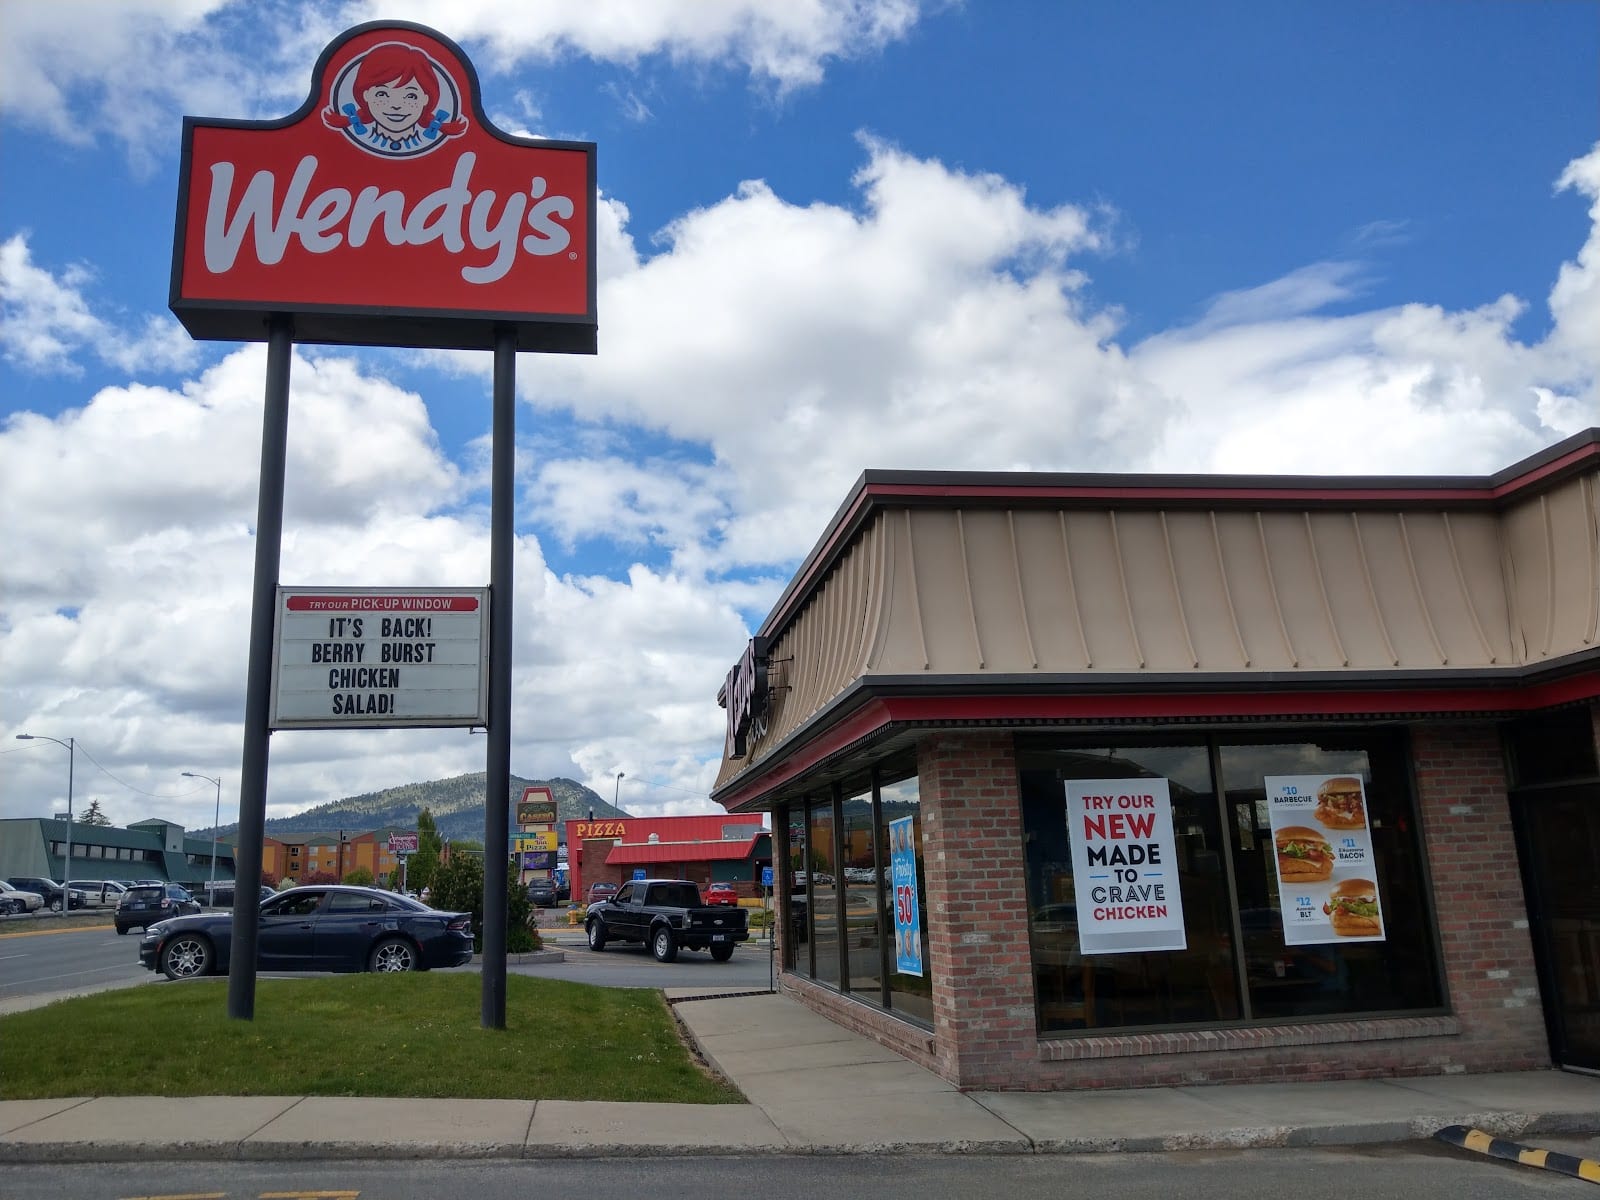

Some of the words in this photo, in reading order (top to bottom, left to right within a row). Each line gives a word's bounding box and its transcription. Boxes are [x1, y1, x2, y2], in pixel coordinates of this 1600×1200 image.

[204, 152, 574, 284] Wendy's
[309, 601, 329, 609] TRY
[329, 601, 349, 609] OUR
[351, 599, 399, 609] PICK-UP
[401, 599, 452, 609] WINDOW
[329, 618, 363, 638] IT'S
[381, 618, 431, 638] BACK!
[312, 643, 365, 663] BERRY
[381, 643, 436, 663] BURST
[329, 668, 400, 690] CHICKEN
[332, 693, 394, 715] SALAD!
[1082, 796, 1114, 810] TRY
[1118, 795, 1155, 809] OUR
[1274, 796, 1312, 804] BARBECUE
[576, 822, 626, 837] PIZZA
[1083, 813, 1156, 840] NEW
[1087, 844, 1162, 867] MADE
[1114, 868, 1138, 883] TO
[1091, 884, 1166, 904] CRAVE
[1093, 905, 1168, 921] CHICKEN
